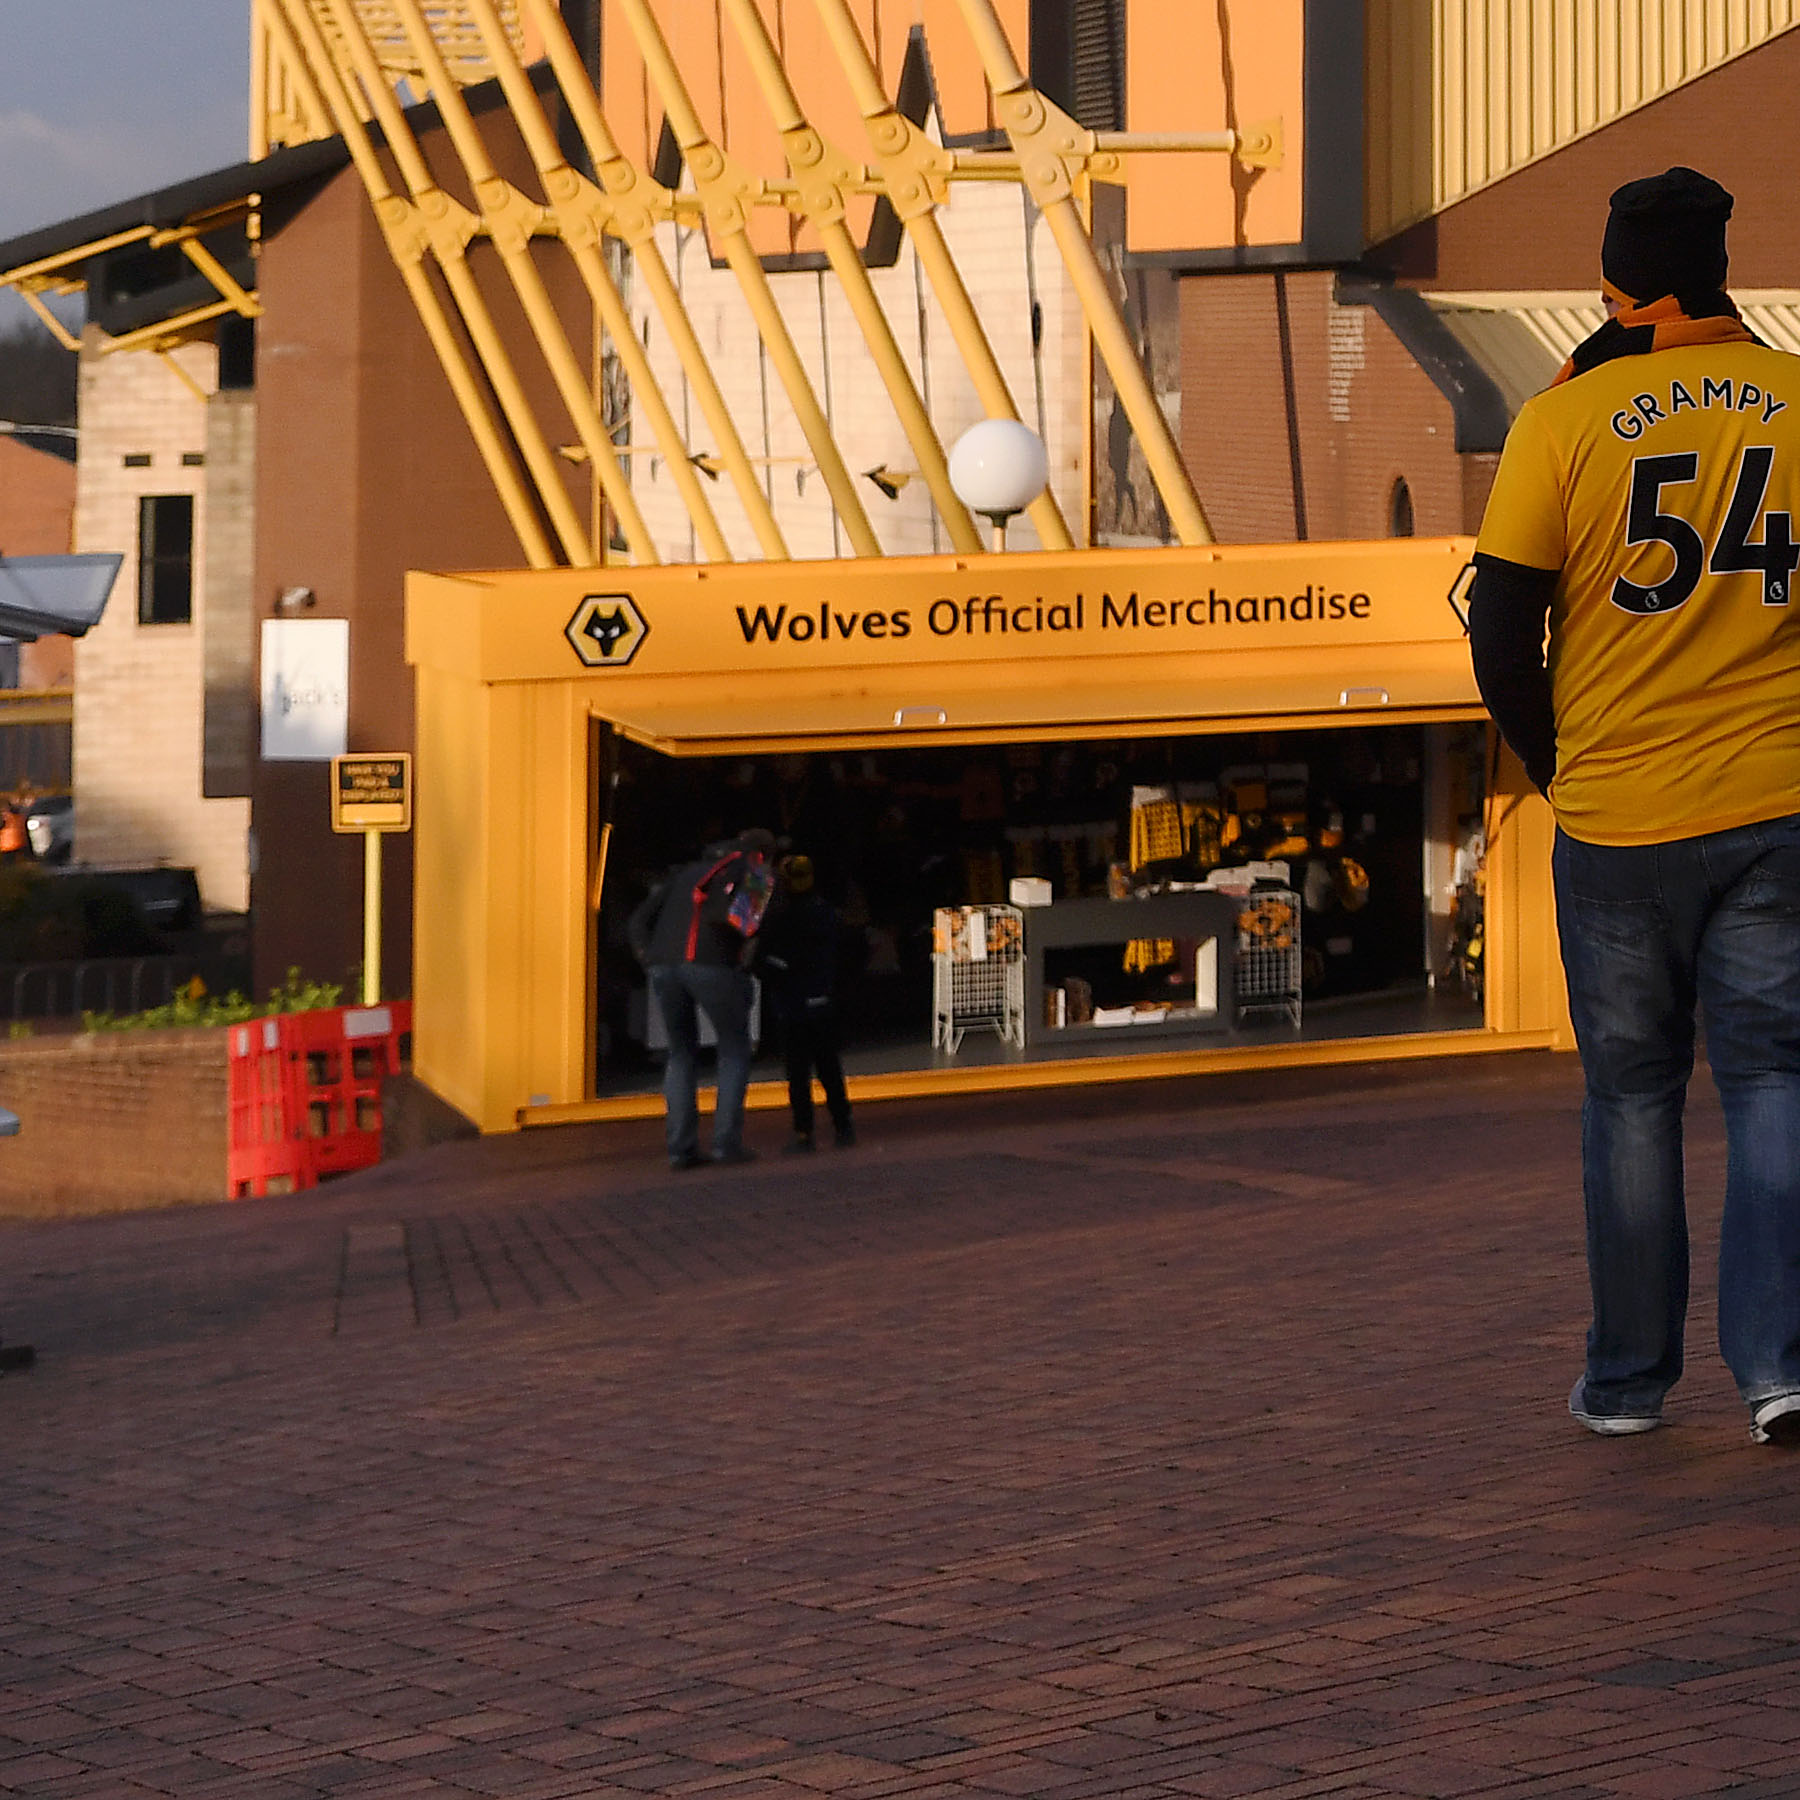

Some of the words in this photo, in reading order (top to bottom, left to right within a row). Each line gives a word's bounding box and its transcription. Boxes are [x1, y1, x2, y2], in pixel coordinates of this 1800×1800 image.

[1610, 376, 1788, 442] GRAMPY
[735, 599, 911, 644] Wolves
[927, 593, 1083, 636] Official
[1100, 585, 1371, 631] Merchandise
